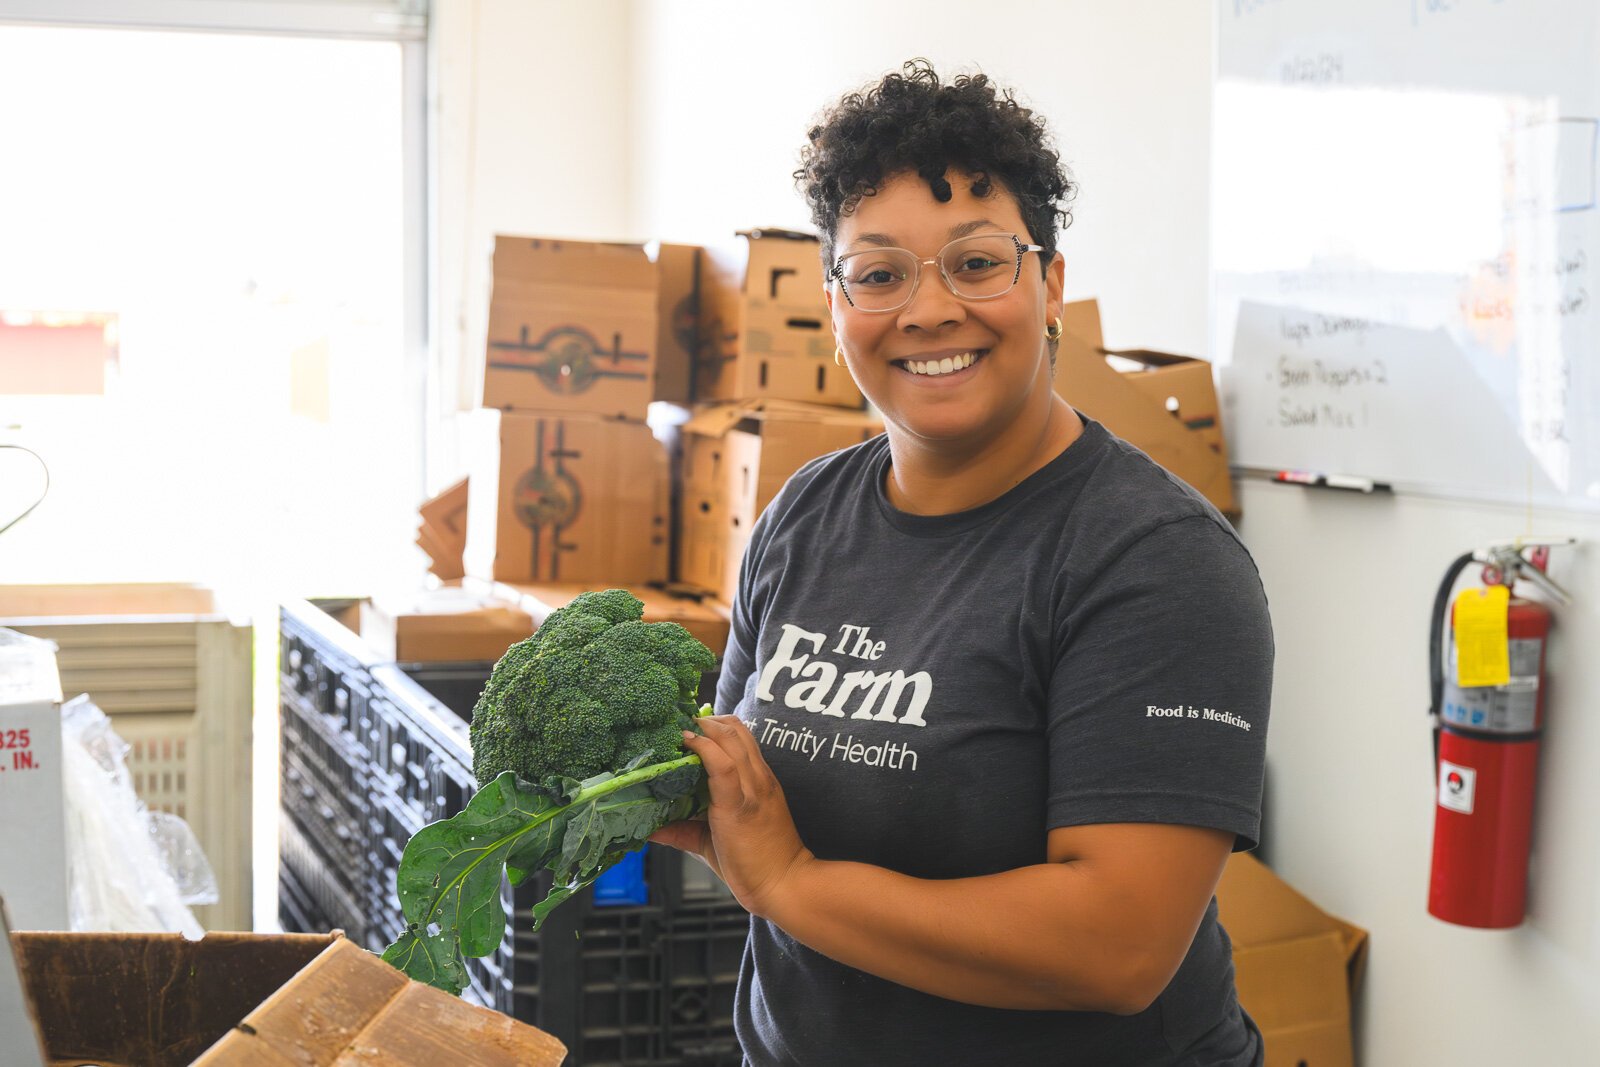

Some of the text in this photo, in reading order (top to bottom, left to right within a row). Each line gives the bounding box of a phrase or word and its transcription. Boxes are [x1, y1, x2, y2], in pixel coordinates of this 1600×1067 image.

[832, 624, 887, 661] The
[756, 623, 933, 727] Farm
[1146, 705, 1252, 732] Food is Medicine
[13, 750, 40, 771] IN.
[760, 718, 828, 762] Trinity
[830, 733, 919, 771] Health
